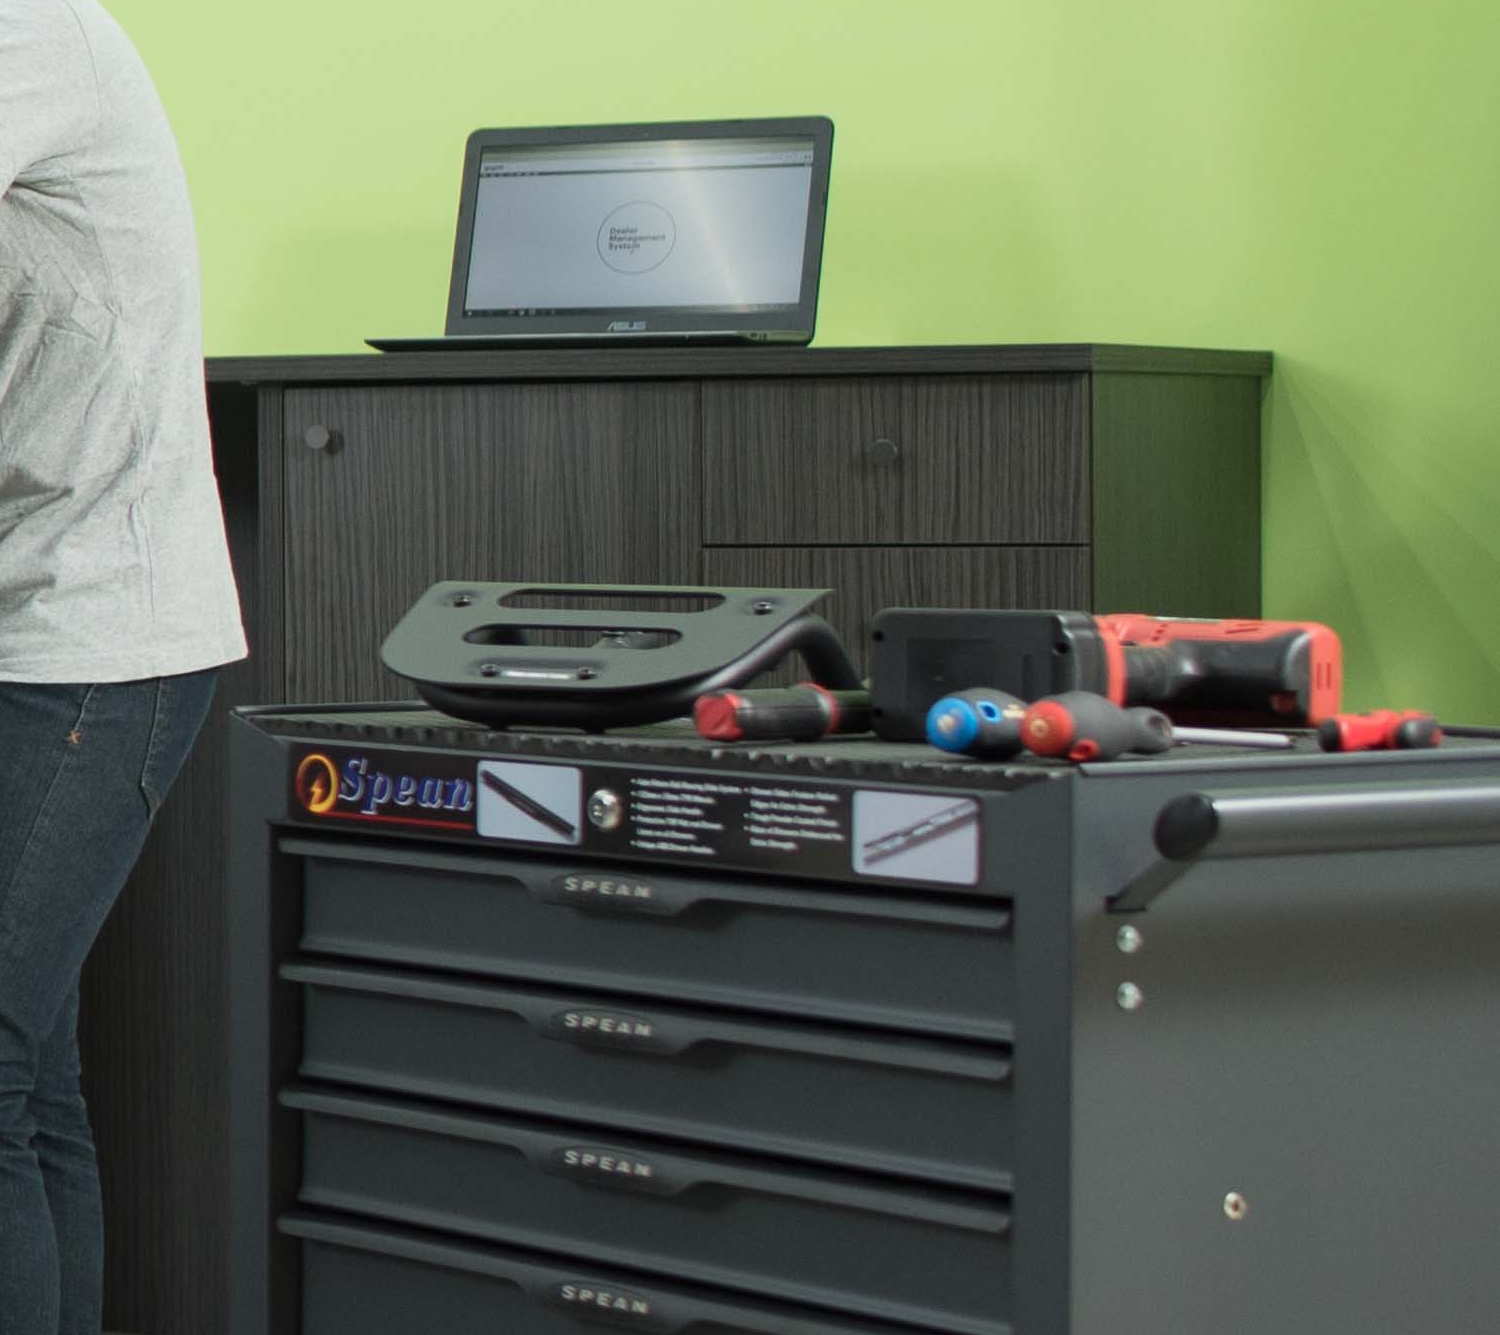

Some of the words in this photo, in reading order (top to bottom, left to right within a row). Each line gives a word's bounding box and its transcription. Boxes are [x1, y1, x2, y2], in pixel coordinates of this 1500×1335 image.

[337, 756, 474, 816] Spean
[563, 875, 652, 898] SPEAN
[563, 1012, 652, 1037] SPEAN
[563, 1149, 652, 1177] SPEAN
[561, 1284, 649, 1314] SPEAN
